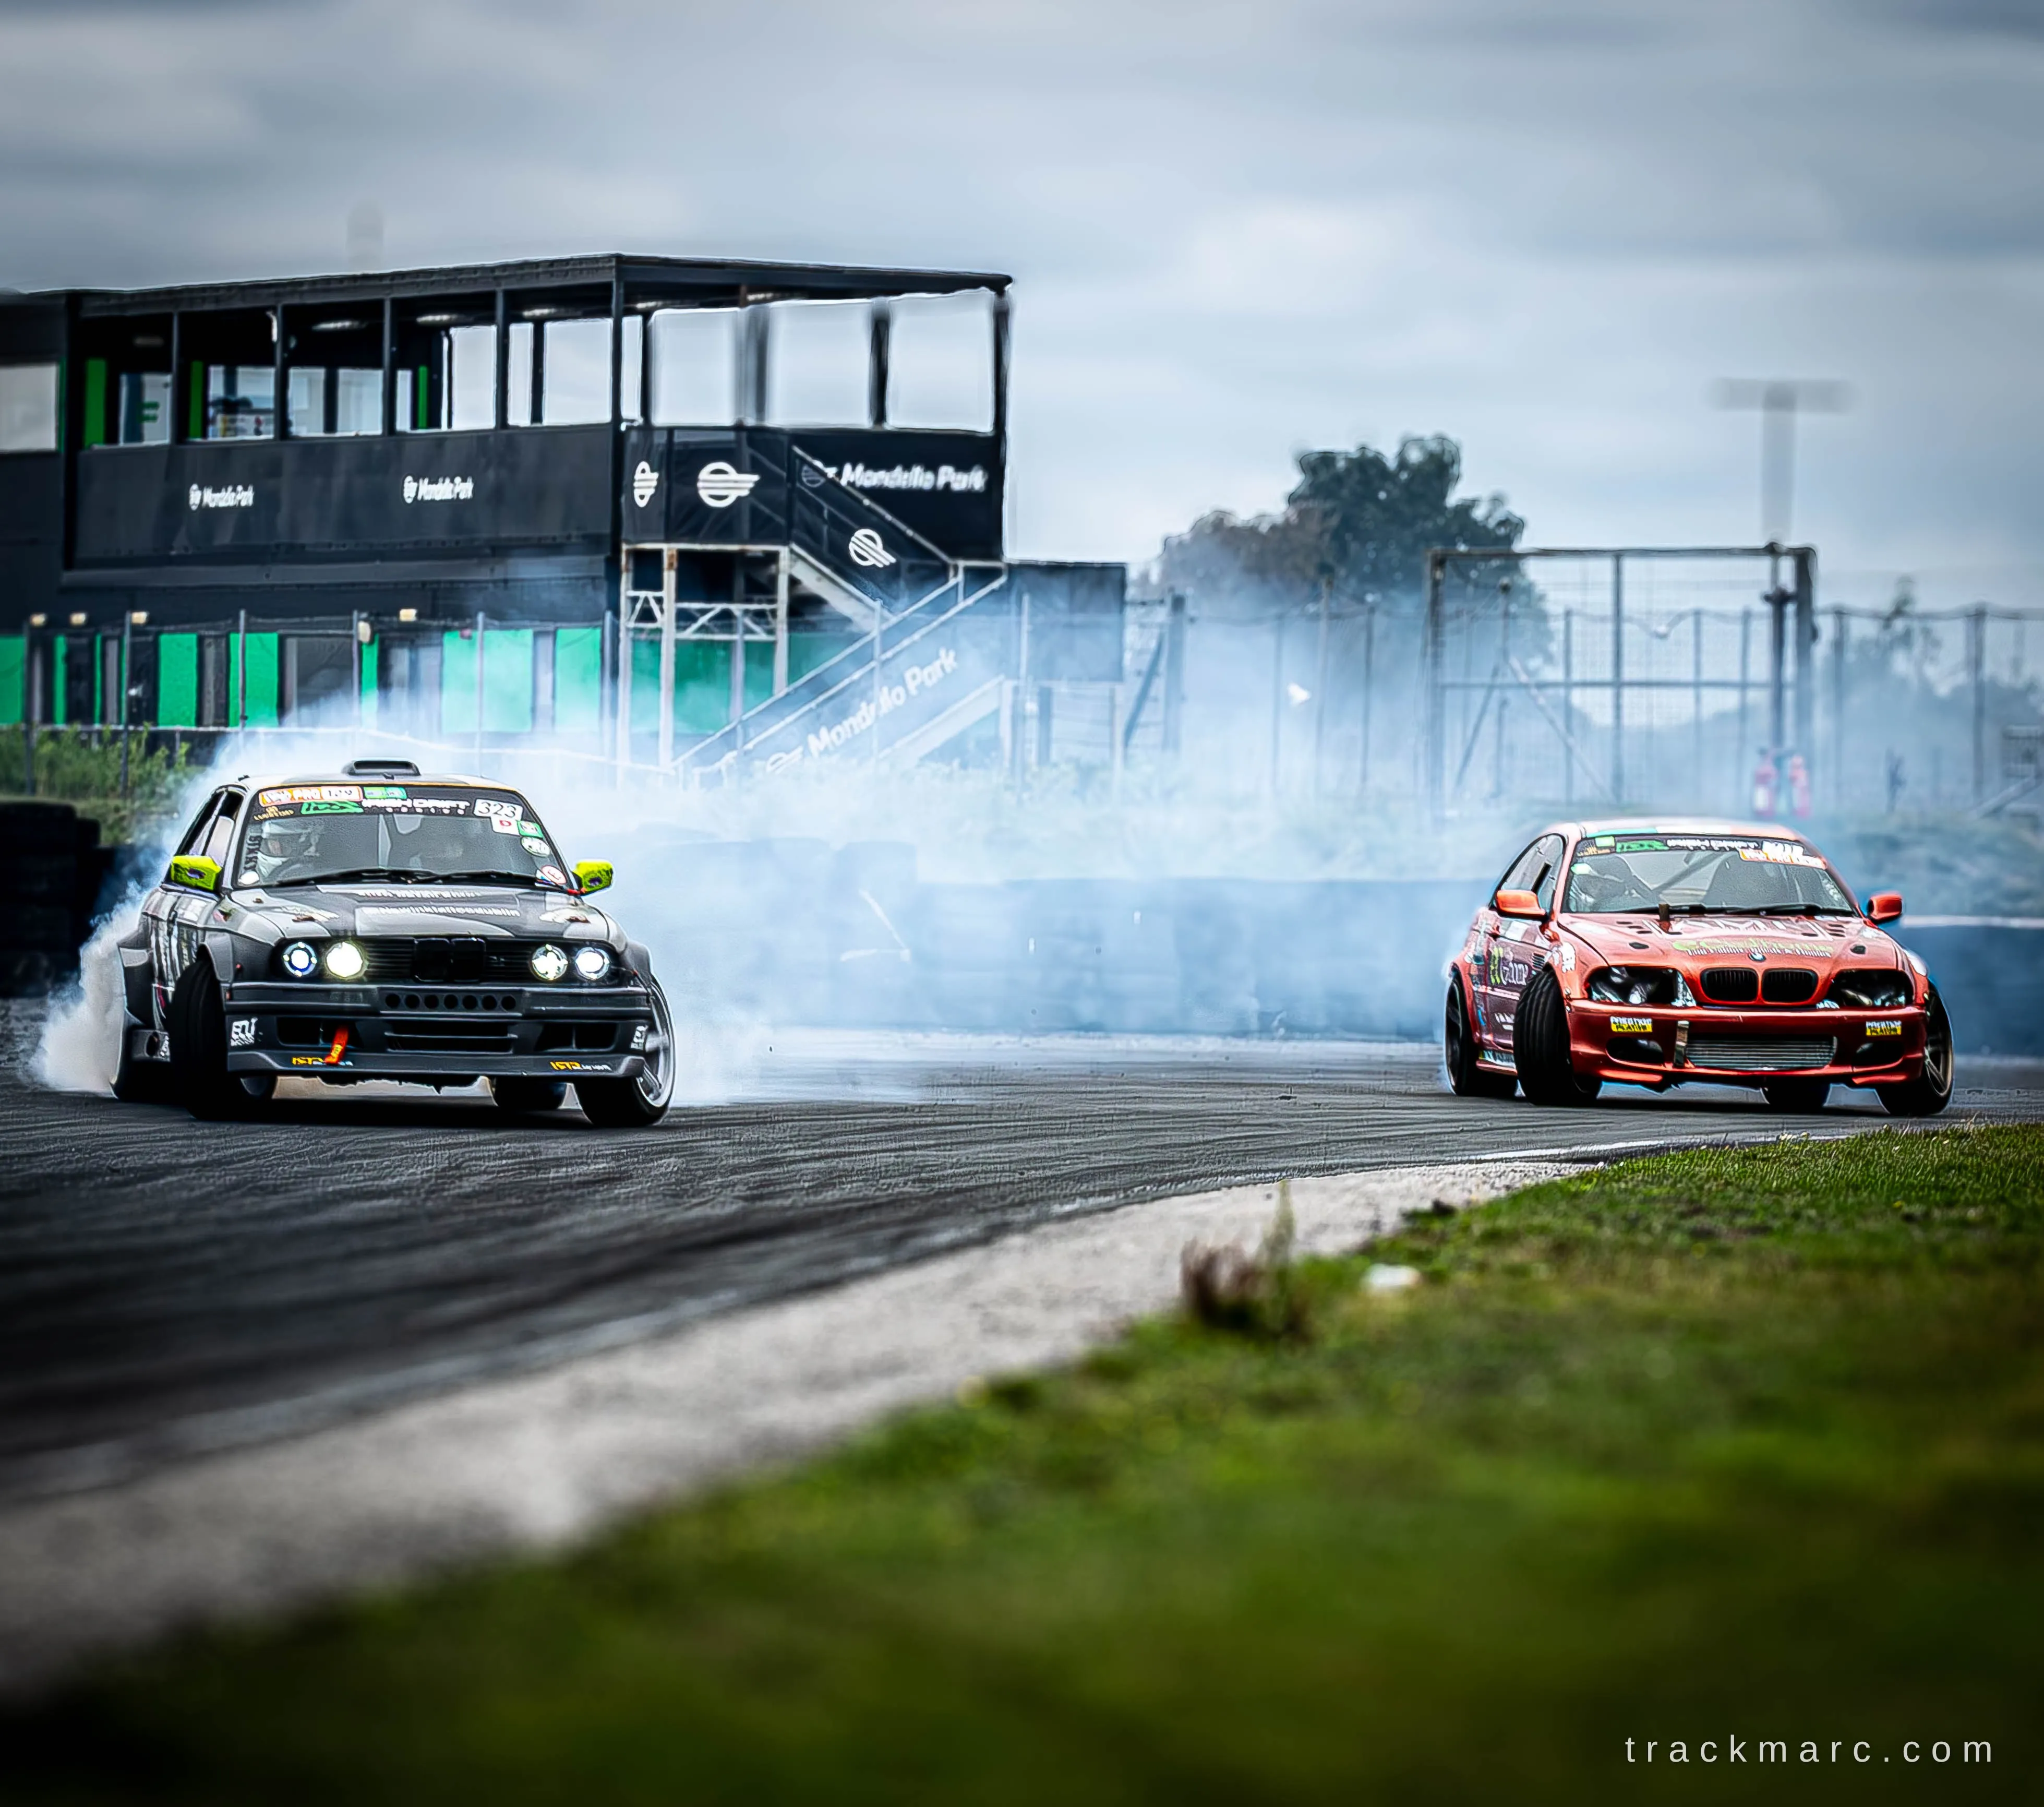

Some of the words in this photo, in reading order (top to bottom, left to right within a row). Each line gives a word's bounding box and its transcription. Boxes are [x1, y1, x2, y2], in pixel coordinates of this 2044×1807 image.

[840, 462, 934, 490] Mondello
[936, 464, 988, 493] Park
[904, 647, 958, 697] Park
[477, 801, 516, 818] 323
